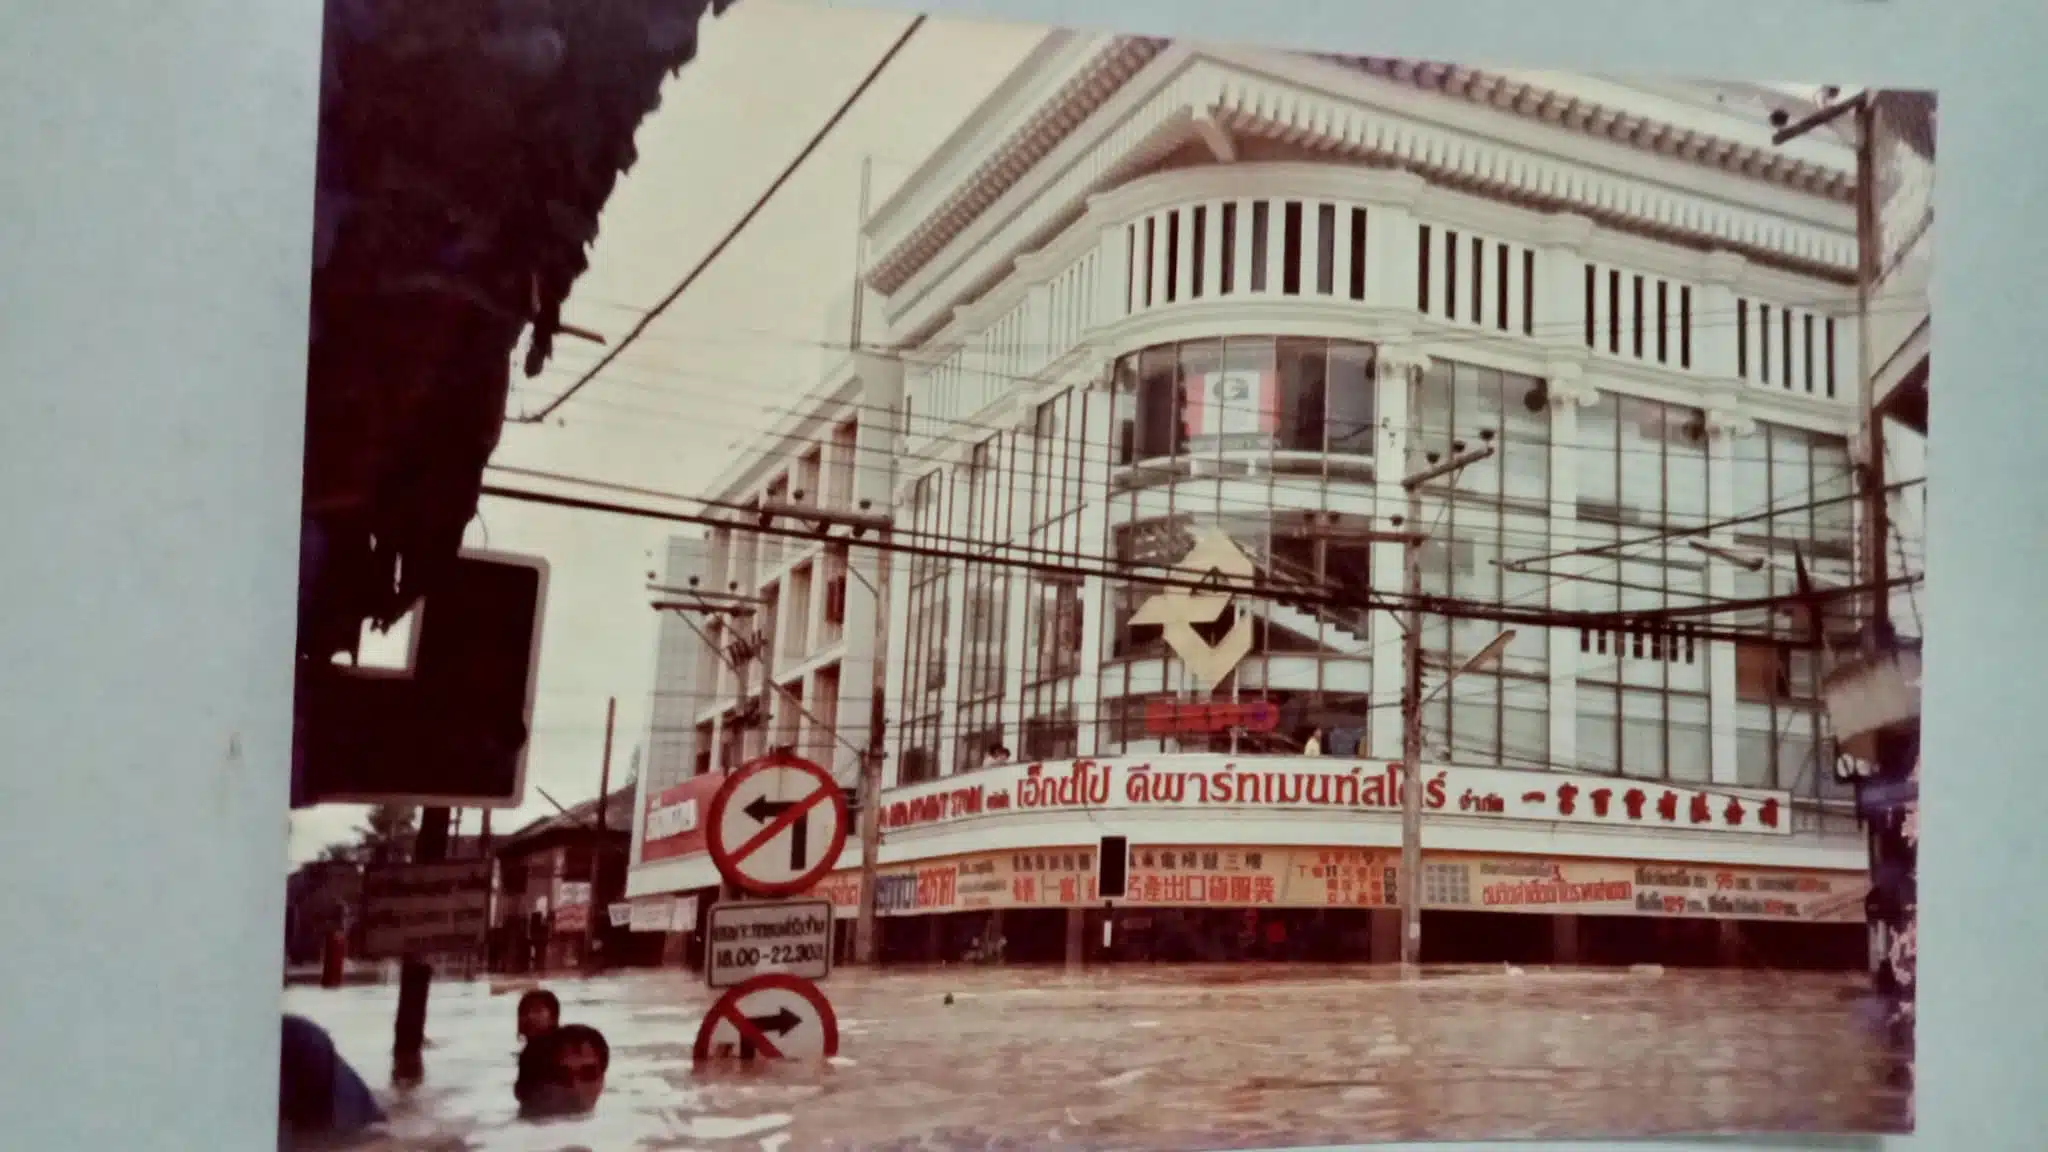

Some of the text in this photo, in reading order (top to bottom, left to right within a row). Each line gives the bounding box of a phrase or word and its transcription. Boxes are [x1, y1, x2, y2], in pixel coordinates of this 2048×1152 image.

[1126, 763, 1447, 809] ดีพาร์ทเมนท์สโร์
